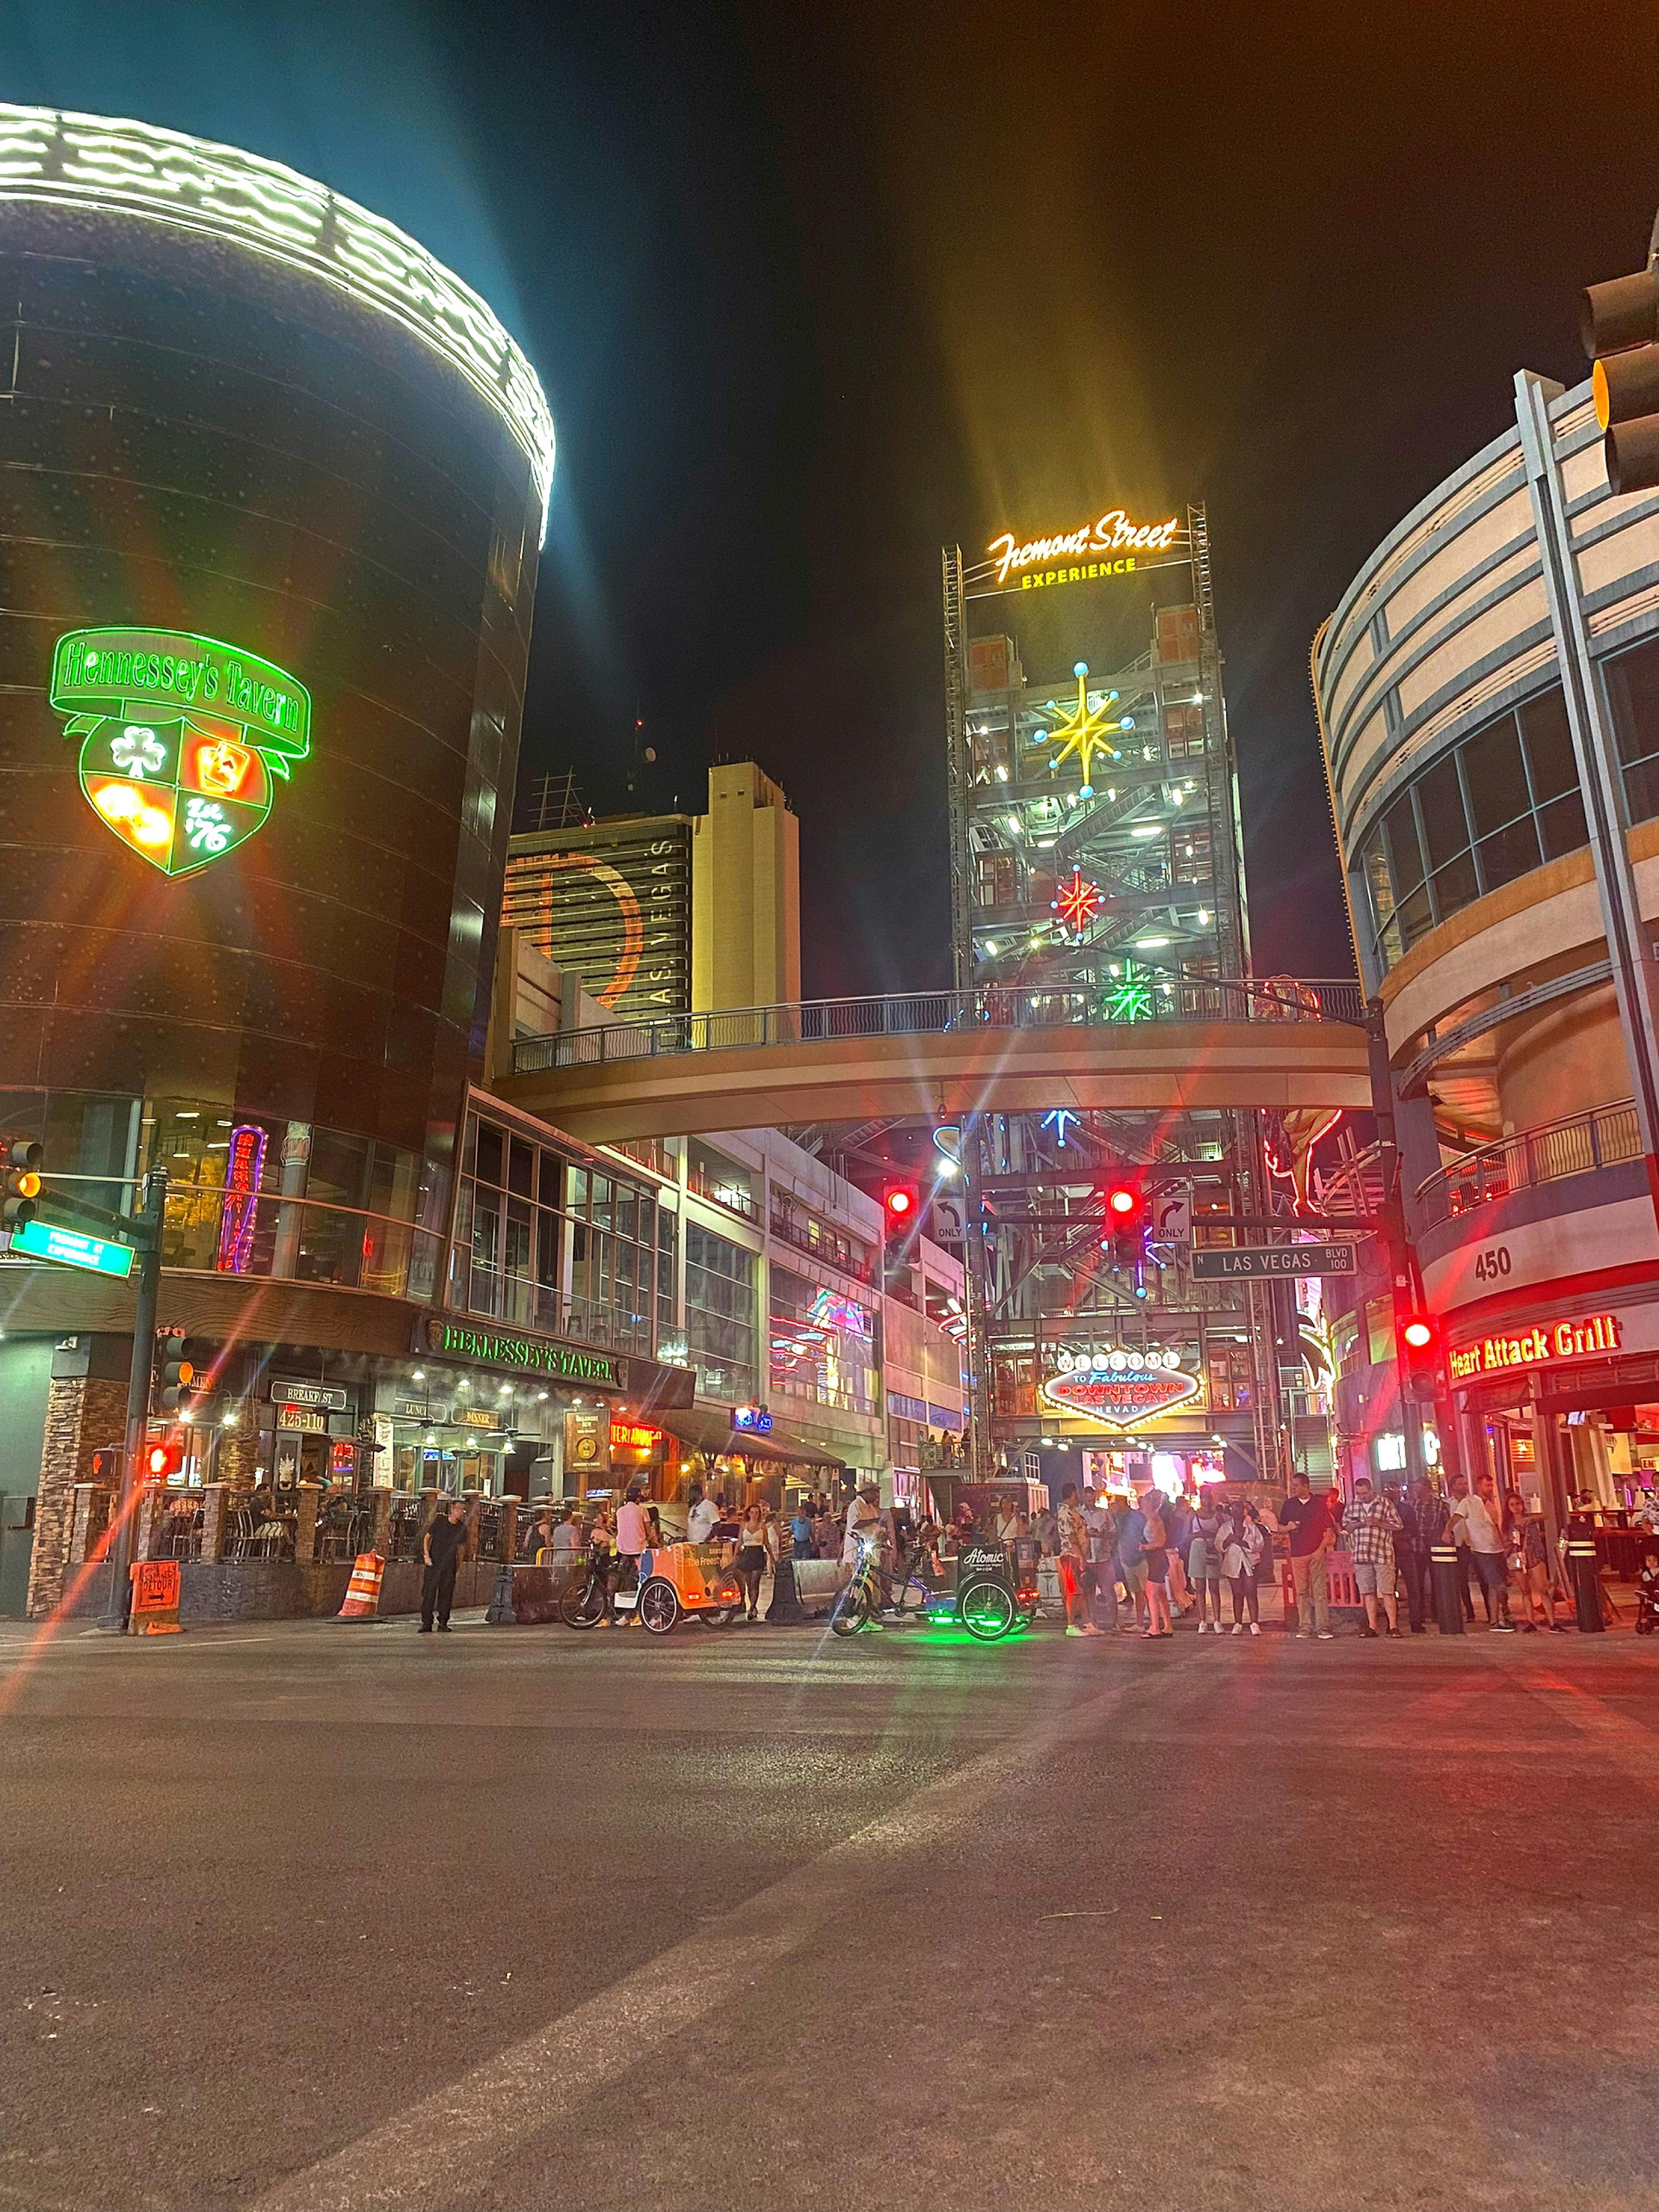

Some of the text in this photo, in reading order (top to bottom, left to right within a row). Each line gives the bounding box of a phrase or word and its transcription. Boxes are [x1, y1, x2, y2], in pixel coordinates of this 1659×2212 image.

[988, 510, 1178, 583] Fremont Street
[1021, 558, 1136, 589] EXPERIENCE
[64, 642, 299, 732] Hennessey's Tavern
[649, 839, 673, 1027] LAS VEGAS
[938, 1228, 962, 1238] ONLY
[1159, 1228, 1185, 1238] ONLY
[1197, 1248, 1348, 1272] N LAS VEGAS BLVD
[1330, 1259, 1347, 1269] 100
[1475, 1246, 1512, 1281] 450
[444, 1325, 615, 1382] HENNESSEY'S TAVERN
[1449, 1315, 1619, 1379] Heart Attack Grill
[1059, 1354, 1177, 1370] WELCOME
[1088, 1370, 1157, 1385] Fabulous
[287, 1388, 334, 1404] BREAKFAST
[1058, 1382, 1184, 1396] DOWNTOWN
[1073, 1393, 1170, 1404] LAS VEGAS
[467, 1411, 490, 1424] DINNER
[1096, 1405, 1148, 1414] NEVADA
[279, 1410, 324, 1430] 425-110
[963, 1548, 1004, 1564] Atomic
[143, 1579, 172, 1591] DETOUR
